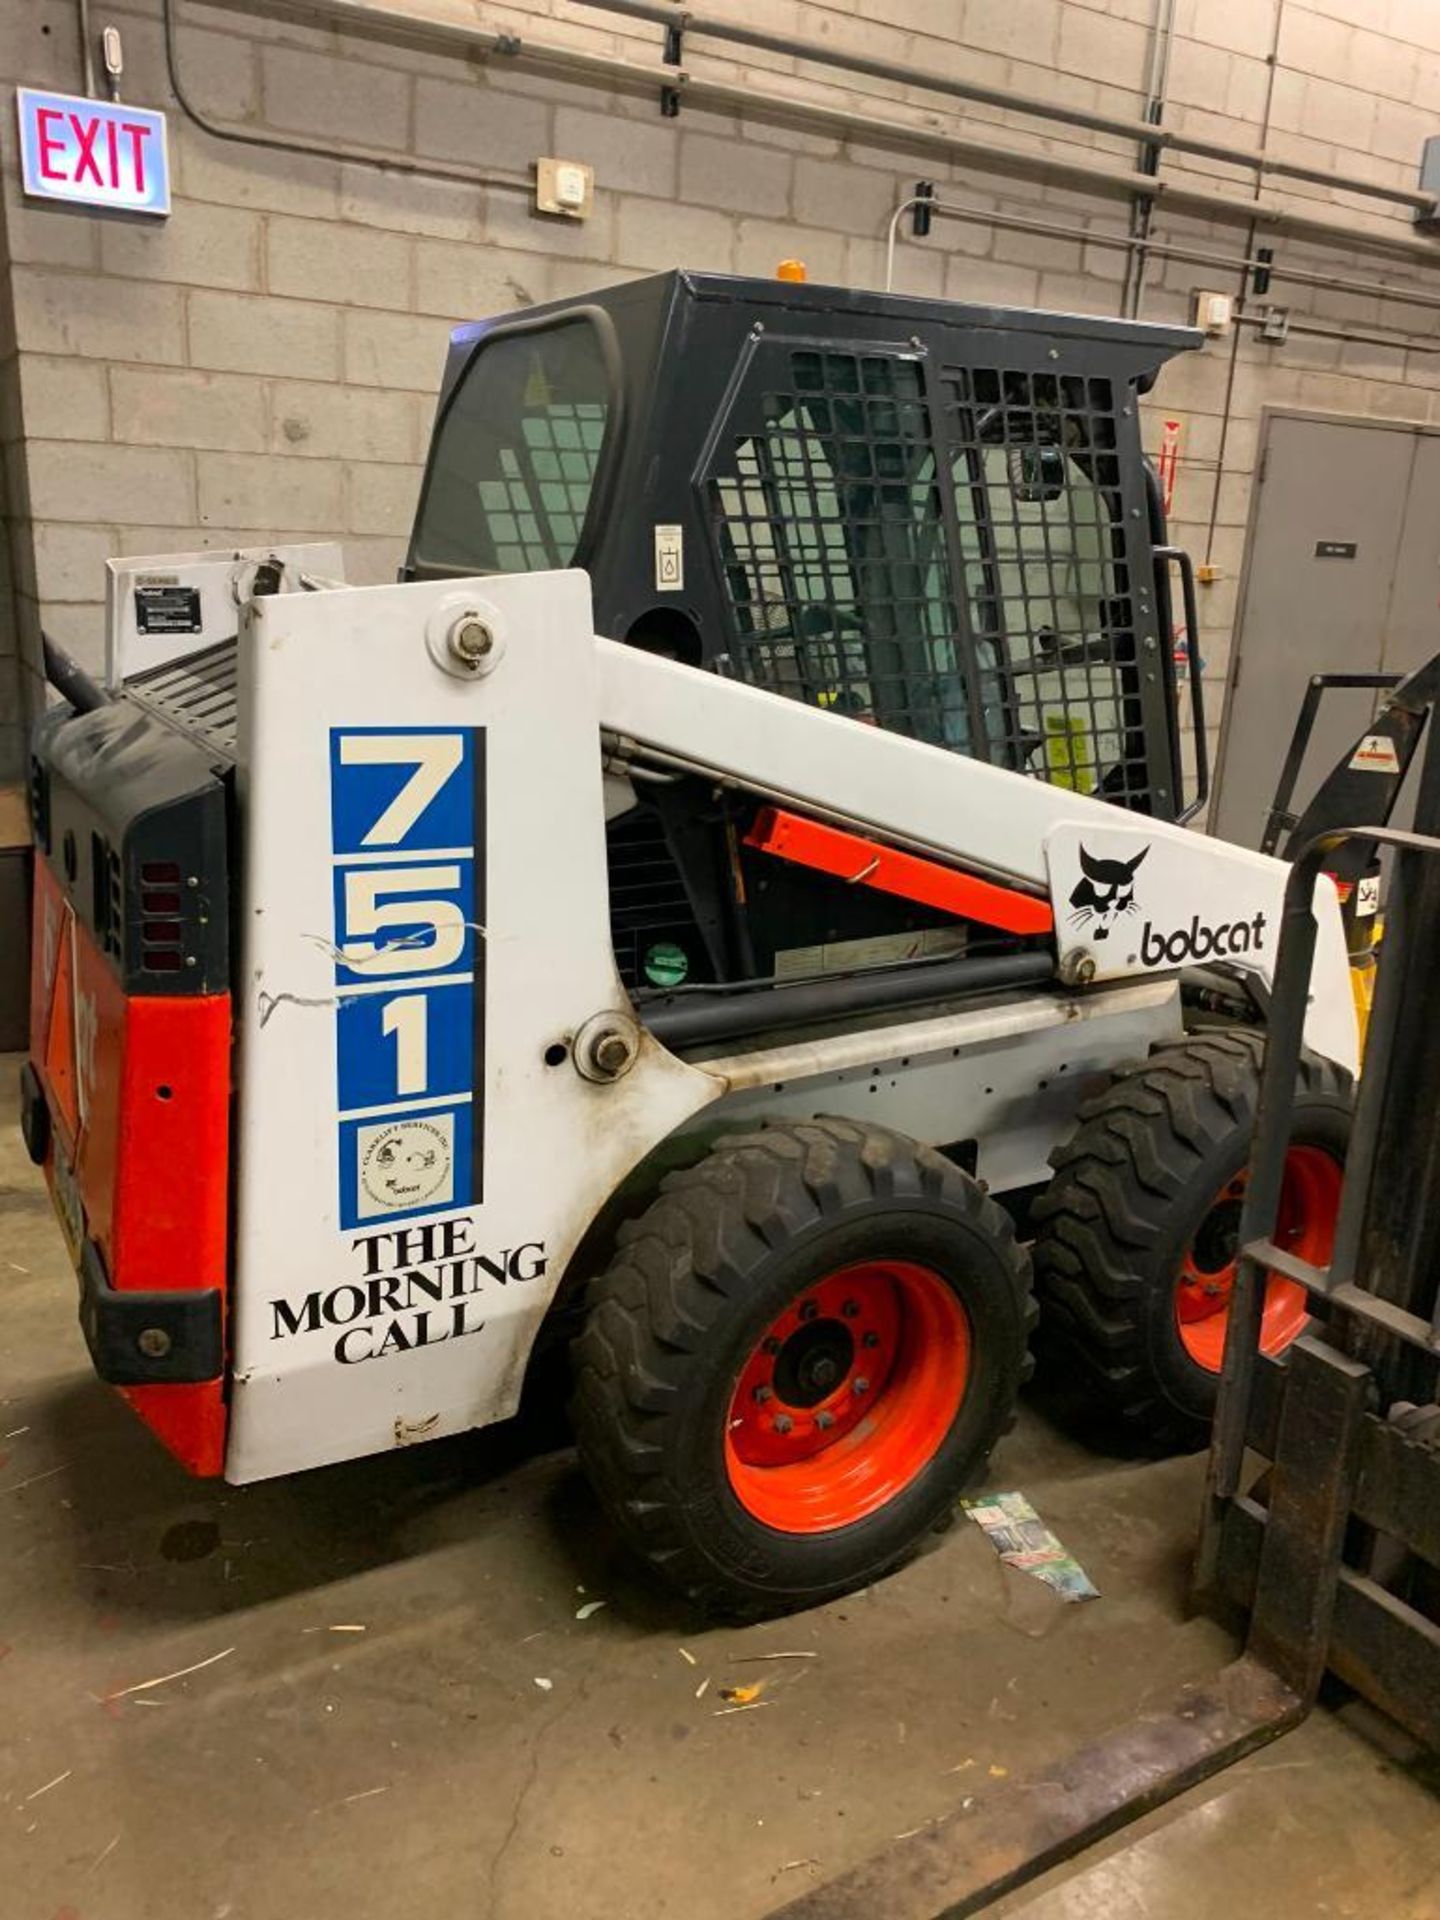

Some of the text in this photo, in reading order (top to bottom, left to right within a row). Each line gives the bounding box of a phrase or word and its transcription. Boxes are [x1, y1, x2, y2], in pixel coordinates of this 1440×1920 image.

[37, 107, 152, 193] EXIT
[1140, 911, 1267, 967] bobcat
[352, 1216, 477, 1277] THE
[268, 1241, 550, 1341] MORNING
[333, 1300, 486, 1365] CALL
